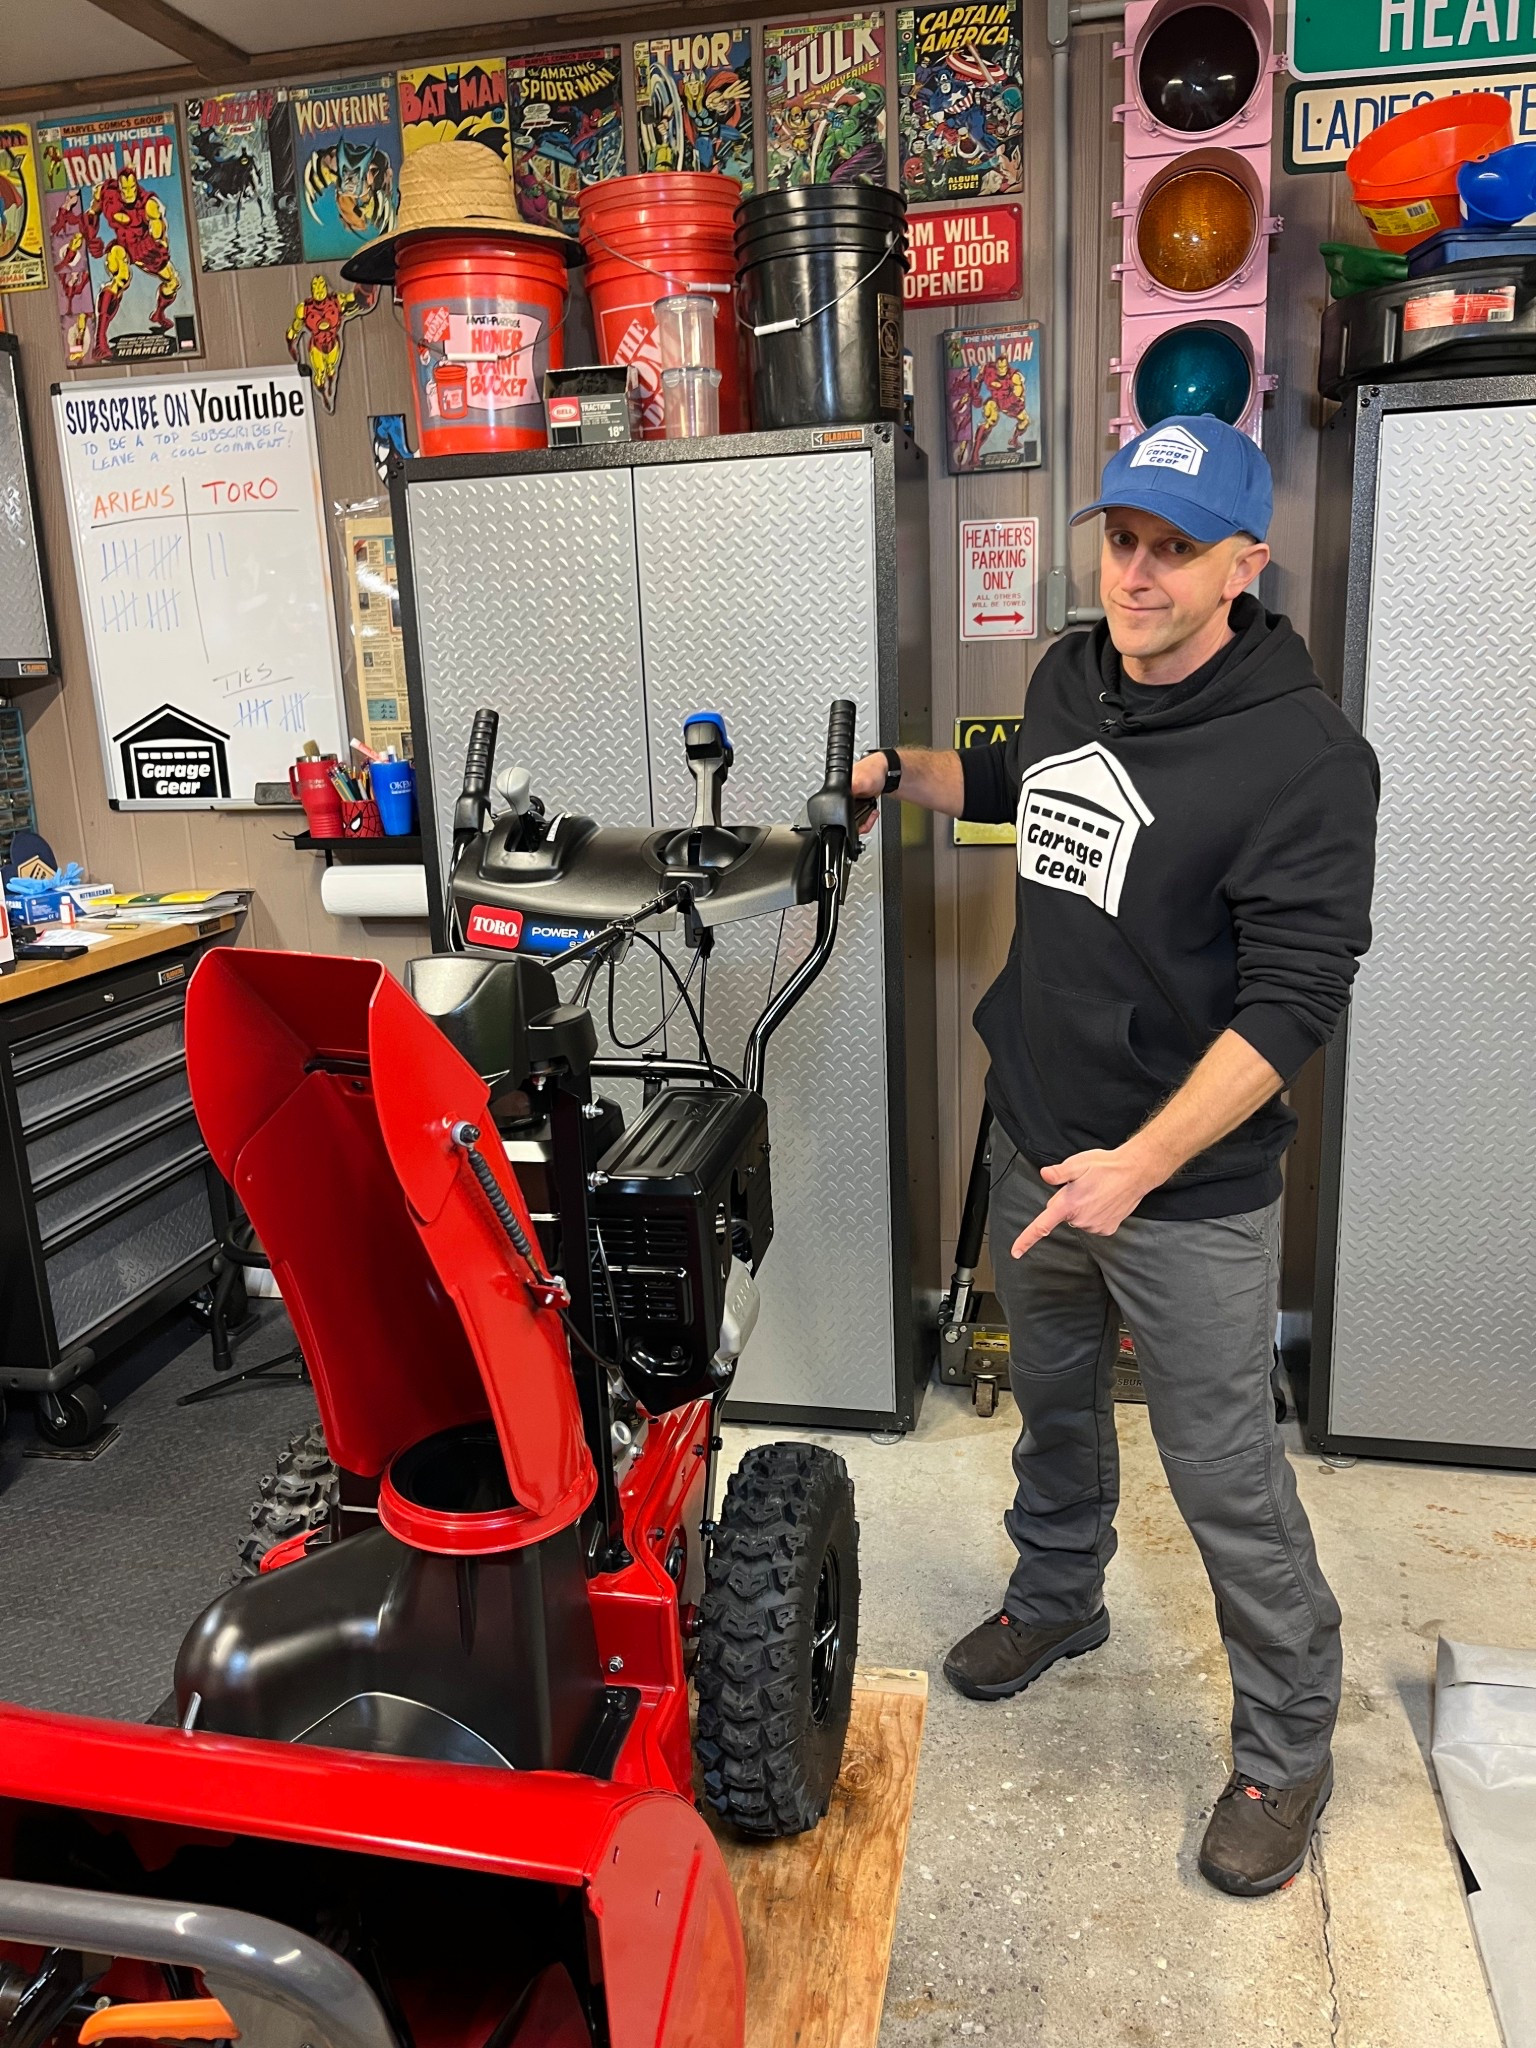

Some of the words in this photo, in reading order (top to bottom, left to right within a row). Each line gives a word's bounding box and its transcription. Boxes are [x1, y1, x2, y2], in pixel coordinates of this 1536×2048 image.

[919, 5, 1010, 35] CAPTAIN
[778, 41, 791, 54] THE
[921, 26, 1010, 54] AMERICA
[650, 32, 730, 72] THOR
[786, 13, 881, 99] HULK
[540, 61, 596, 79] AMAZING
[821, 58, 880, 94] WOLVERINE!
[63, 124, 96, 135] MARVEL
[98, 120, 132, 131] COMICS
[134, 115, 164, 126] GROUP
[295, 92, 390, 135] WOLVERINE
[67, 136, 89, 148] THE
[93, 126, 164, 143] INVINCIBLE
[63, 147, 119, 189] IRON
[122, 139, 173, 181] MAN
[948, 174, 979, 184] ALBUM
[949, 181, 979, 191] ISSUE!
[943, 215, 995, 244] WILL
[926, 246, 945, 271] IF
[954, 240, 1009, 269] DOOR
[903, 268, 983, 299] OPENED
[471, 329, 523, 353] HOMER
[982, 330, 1029, 341] INVINCIBLE
[118, 345, 171, 357] HAMMER!
[961, 344, 997, 368] IRON
[1000, 339, 1034, 363] MAN
[470, 378, 527, 397] BUCKET
[65, 394, 159, 435] SUBSCRIBE
[164, 392, 190, 428] ON
[191, 381, 305, 424] YouTube
[82, 441, 98, 456] TO
[109, 438, 126, 451] BE
[135, 435, 144, 447] A
[154, 433, 179, 445] TOP
[823, 430, 862, 442] GLADIATOR
[91, 453, 135, 471] LEAVE
[150, 452, 159, 463] A
[171, 446, 207, 458] COOL
[1145, 449, 1189, 460] Garage
[1149, 456, 1179, 465] Gear
[94, 484, 175, 519] ARIENS
[201, 476, 279, 505] TORO
[965, 526, 1033, 549] HEATHER'S
[971, 549, 1027, 570] PARKING
[982, 570, 1014, 591] ONLY
[994, 592, 1022, 600] OTHERS
[212, 662, 273, 691] TIES
[964, 724, 1020, 749] CA
[141, 763, 211, 780] Garage
[155, 780, 201, 796] Gear
[1027, 823, 1103, 869] Garage
[1035, 854, 1087, 887] Gear
[473, 916, 519, 938] TORO
[531, 926, 579, 939] POWER
[583, 929, 602, 939] M
